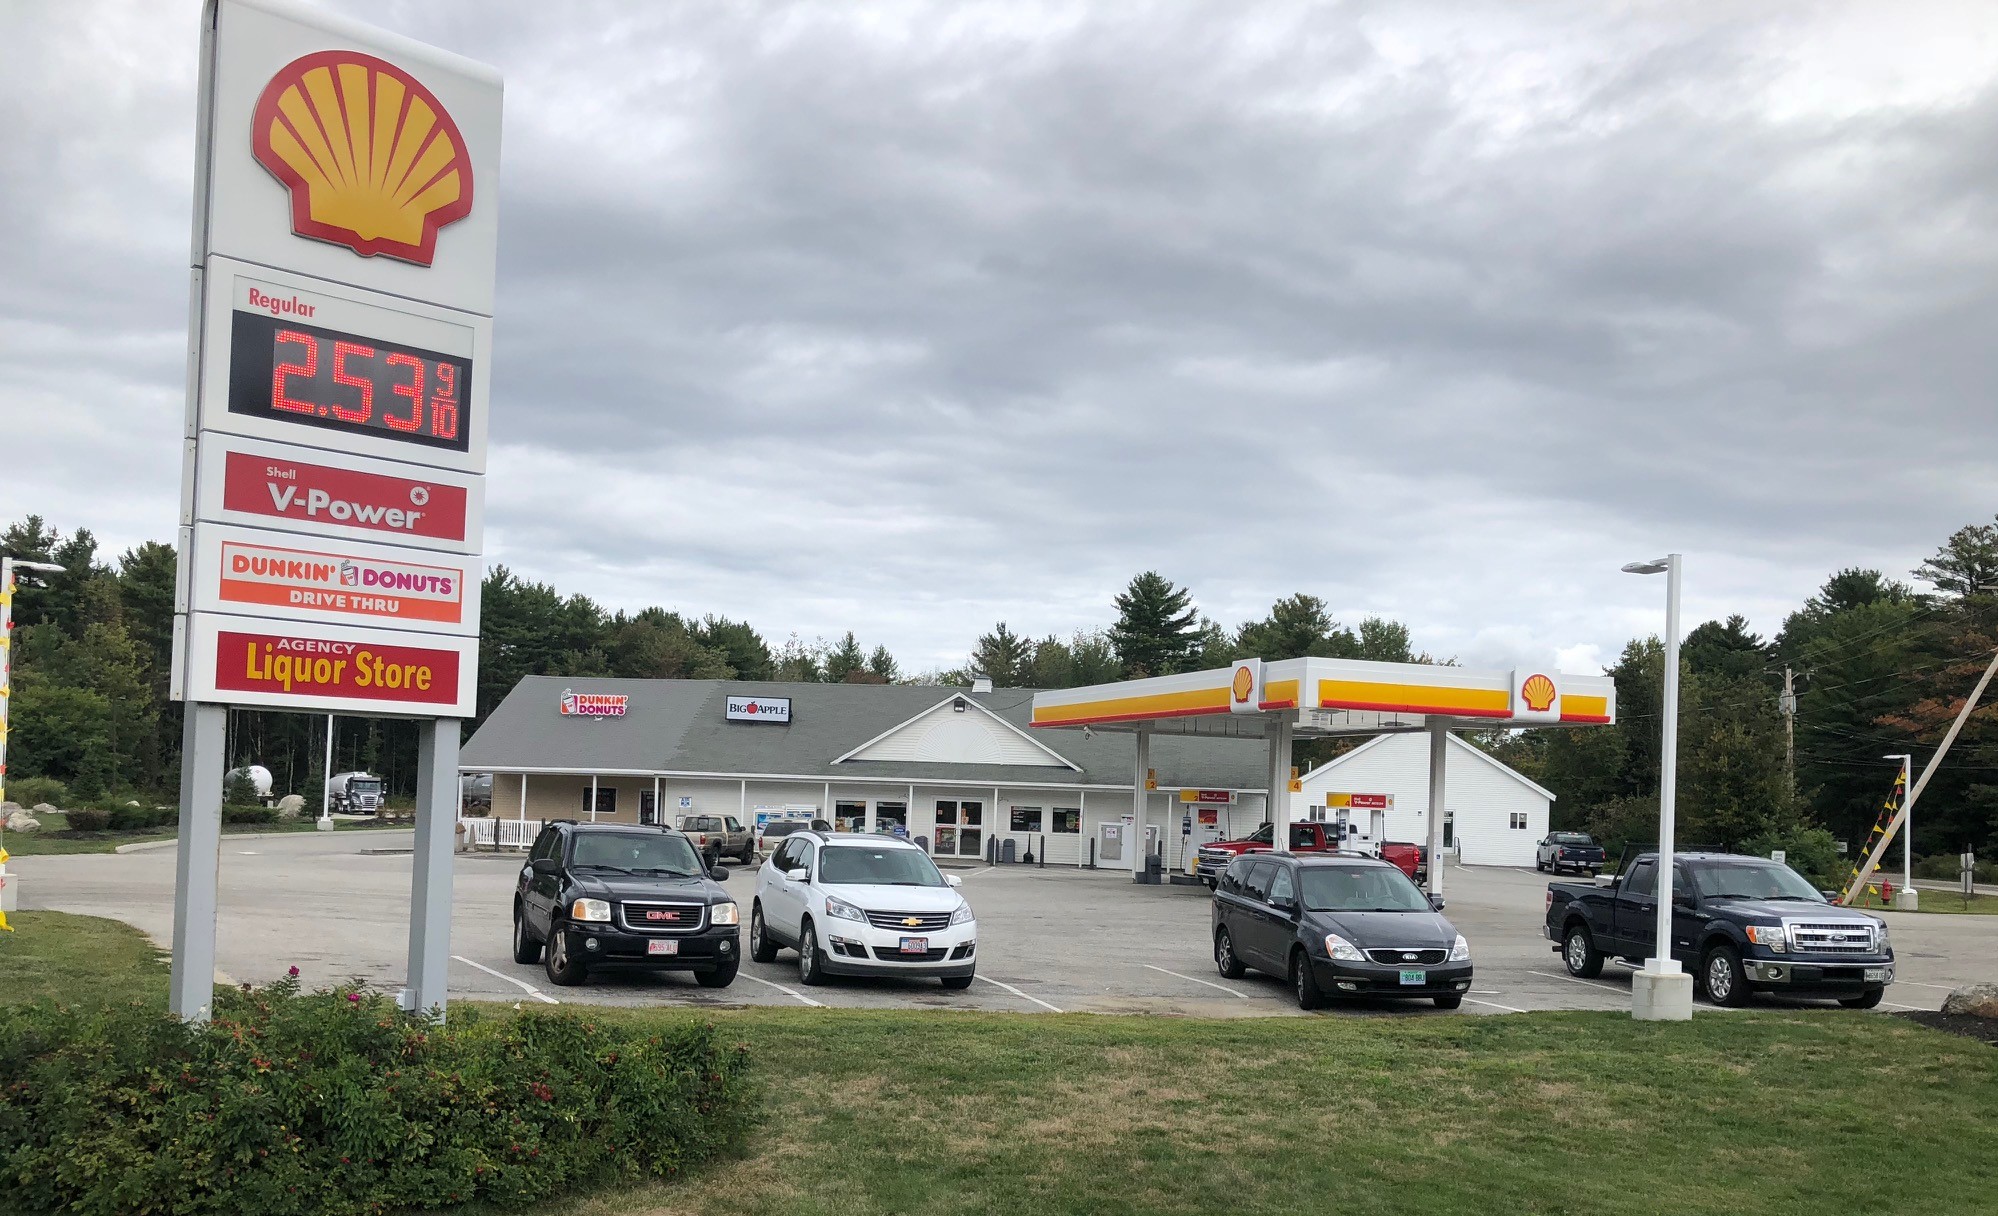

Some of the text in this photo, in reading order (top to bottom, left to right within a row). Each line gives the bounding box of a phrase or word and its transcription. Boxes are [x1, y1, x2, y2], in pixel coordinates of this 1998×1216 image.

[249, 287, 316, 318] Regular
[272, 329, 425, 432] 2.53
[436, 362, 454, 397] 9
[431, 401, 458, 439] 10
[266, 466, 296, 480] Shell
[266, 482, 421, 530] V-Power
[232, 554, 452, 595] DUNKIN' DONUTS
[290, 590, 399, 613] DRIVE THRU
[277, 638, 356, 655] AGENCY
[246, 642, 432, 692] Liquor Store
[579, 695, 627, 705] DUNKIN'
[579, 705, 624, 715] DONUTS
[757, 704, 787, 715] APPLE
[1293, 782, 1299, 790] 4
[646, 910, 680, 920] GMC
